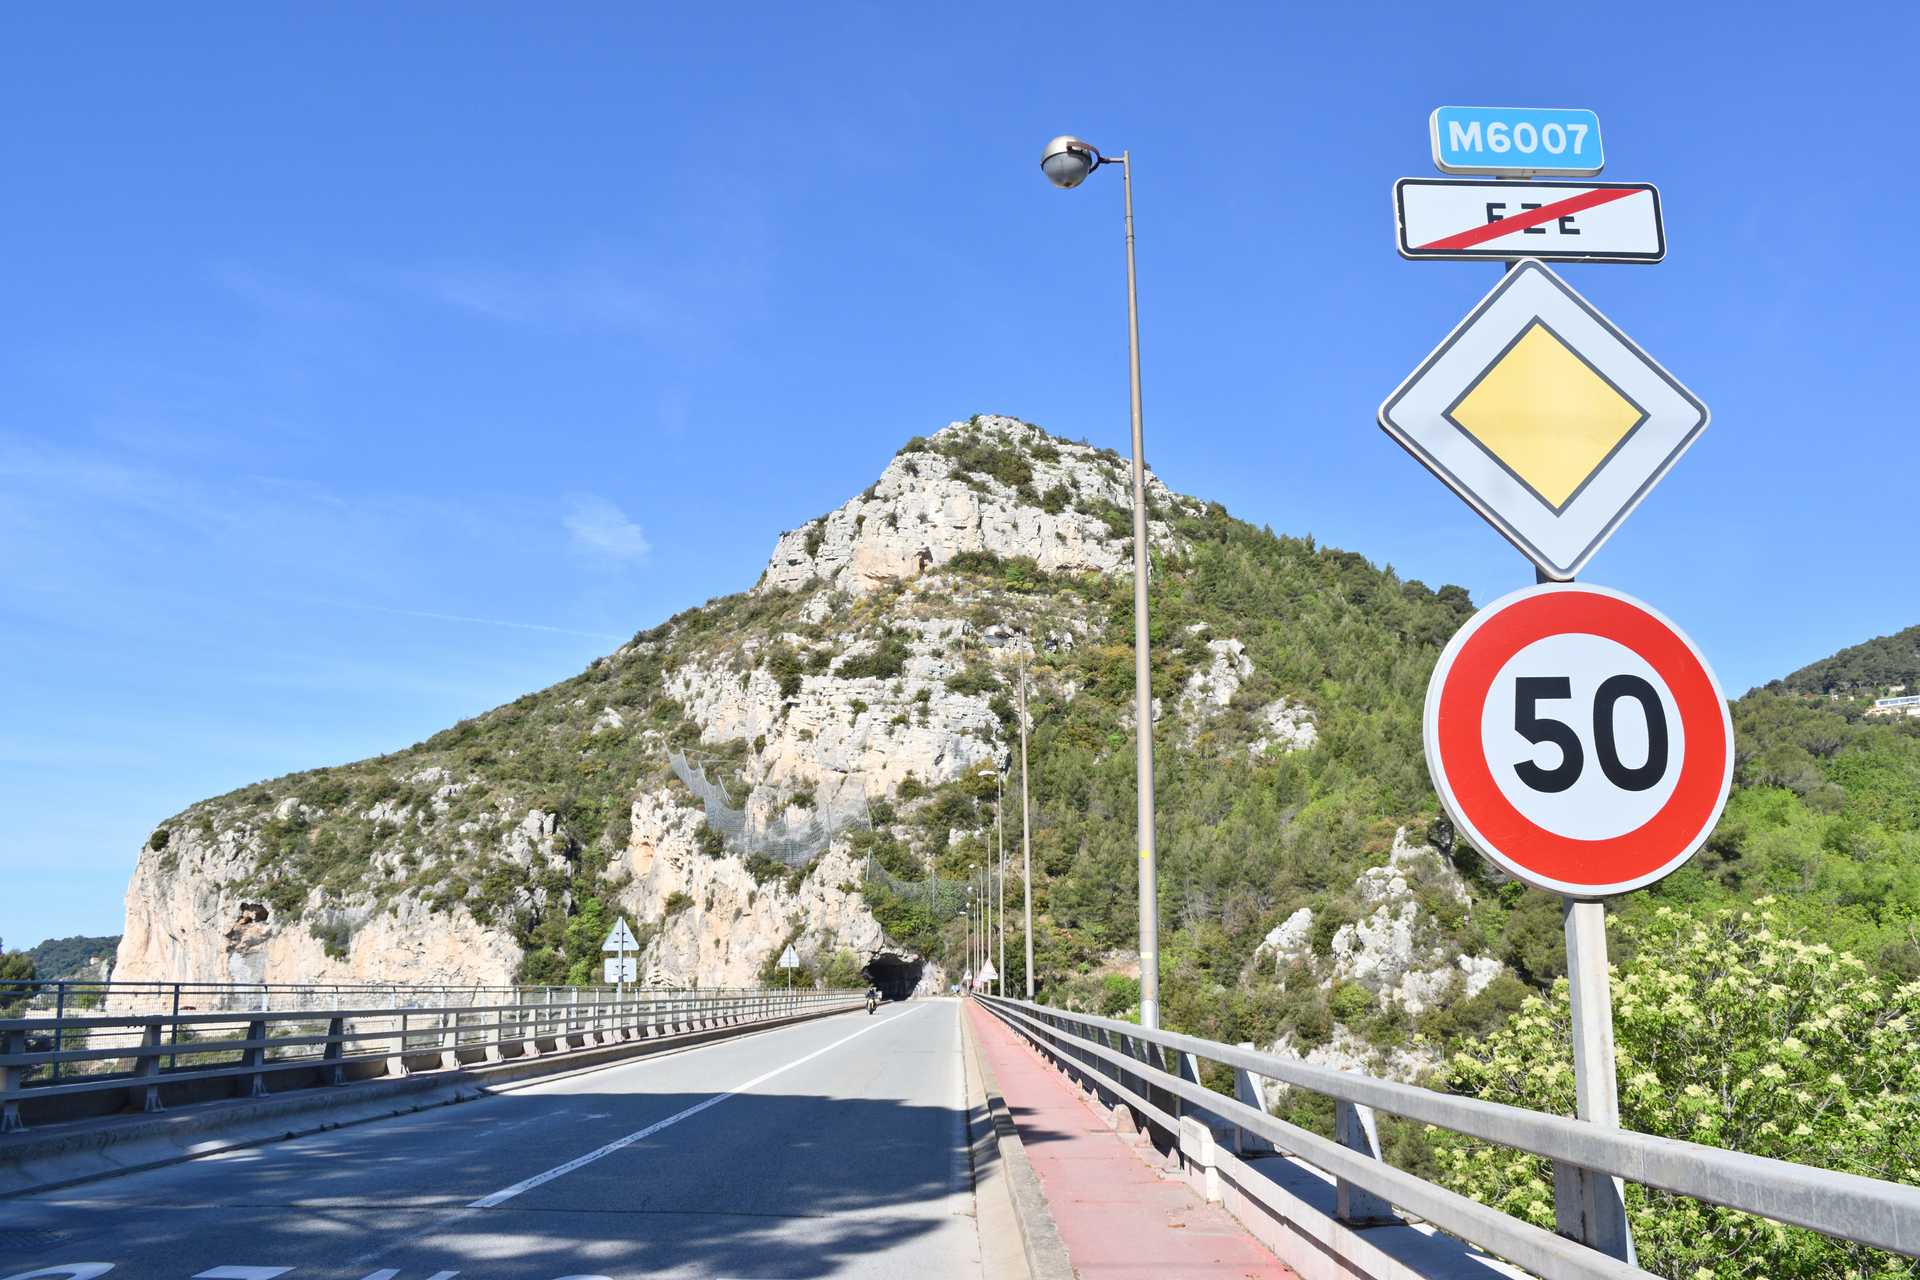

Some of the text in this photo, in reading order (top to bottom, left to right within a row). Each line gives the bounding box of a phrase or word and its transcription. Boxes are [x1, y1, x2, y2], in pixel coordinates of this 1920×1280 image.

[1448, 121, 1588, 154] M6007
[1486, 202, 1580, 235] EZE
[1513, 674, 1669, 793] 50
